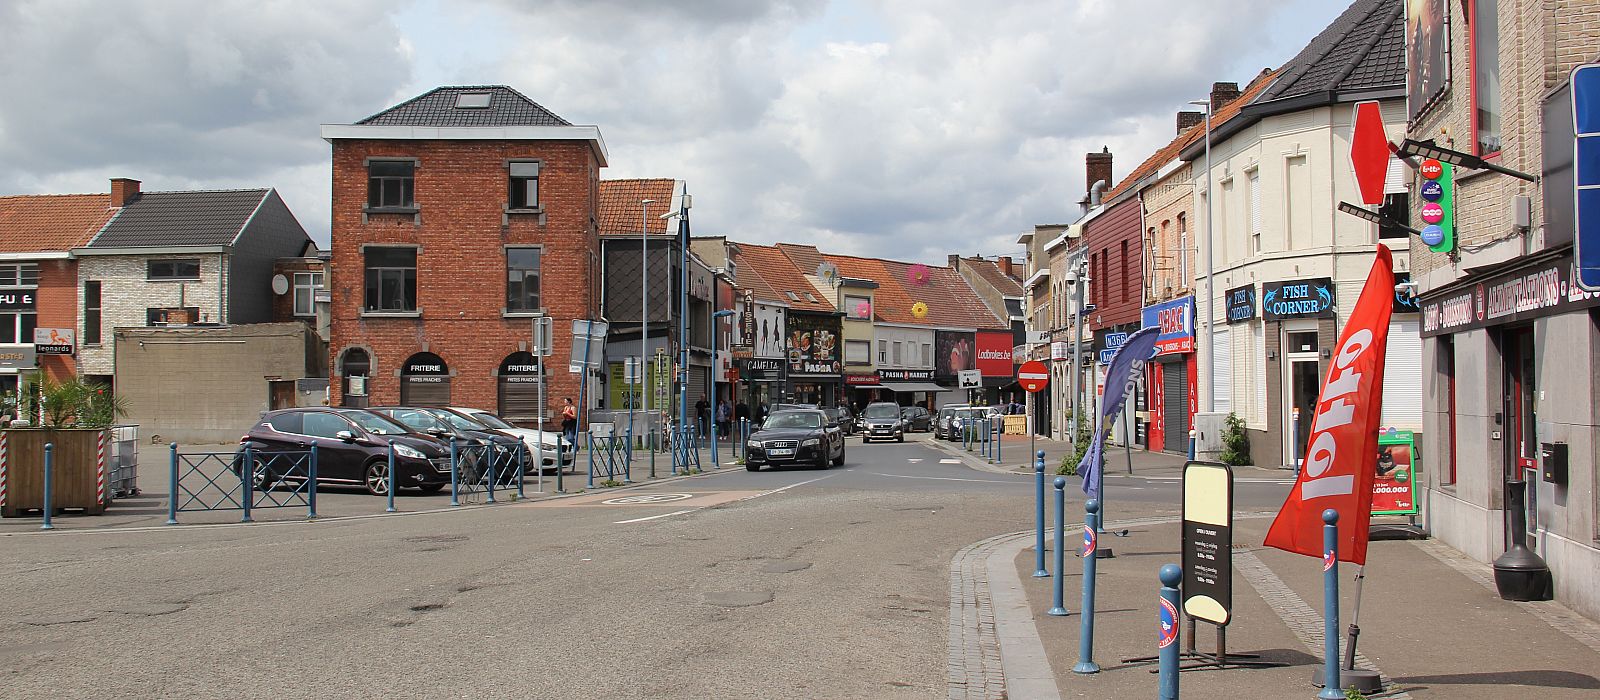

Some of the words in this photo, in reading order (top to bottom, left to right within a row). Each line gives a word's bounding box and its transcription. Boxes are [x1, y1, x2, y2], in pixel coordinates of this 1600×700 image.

[1234, 289, 1246, 305] FISH
[1282, 284, 1309, 299] FISH
[1487, 266, 1559, 320] ALIMENTATIONS
[1230, 305, 1251, 321] CORNER
[1273, 300, 1320, 315] CORNER
[1107, 334, 1126, 347] N366
[38, 345, 69, 353] leonards
[410, 364, 441, 372] FRITERIE
[507, 364, 538, 372] FRITERIE
[885, 370, 903, 379] PASHA
